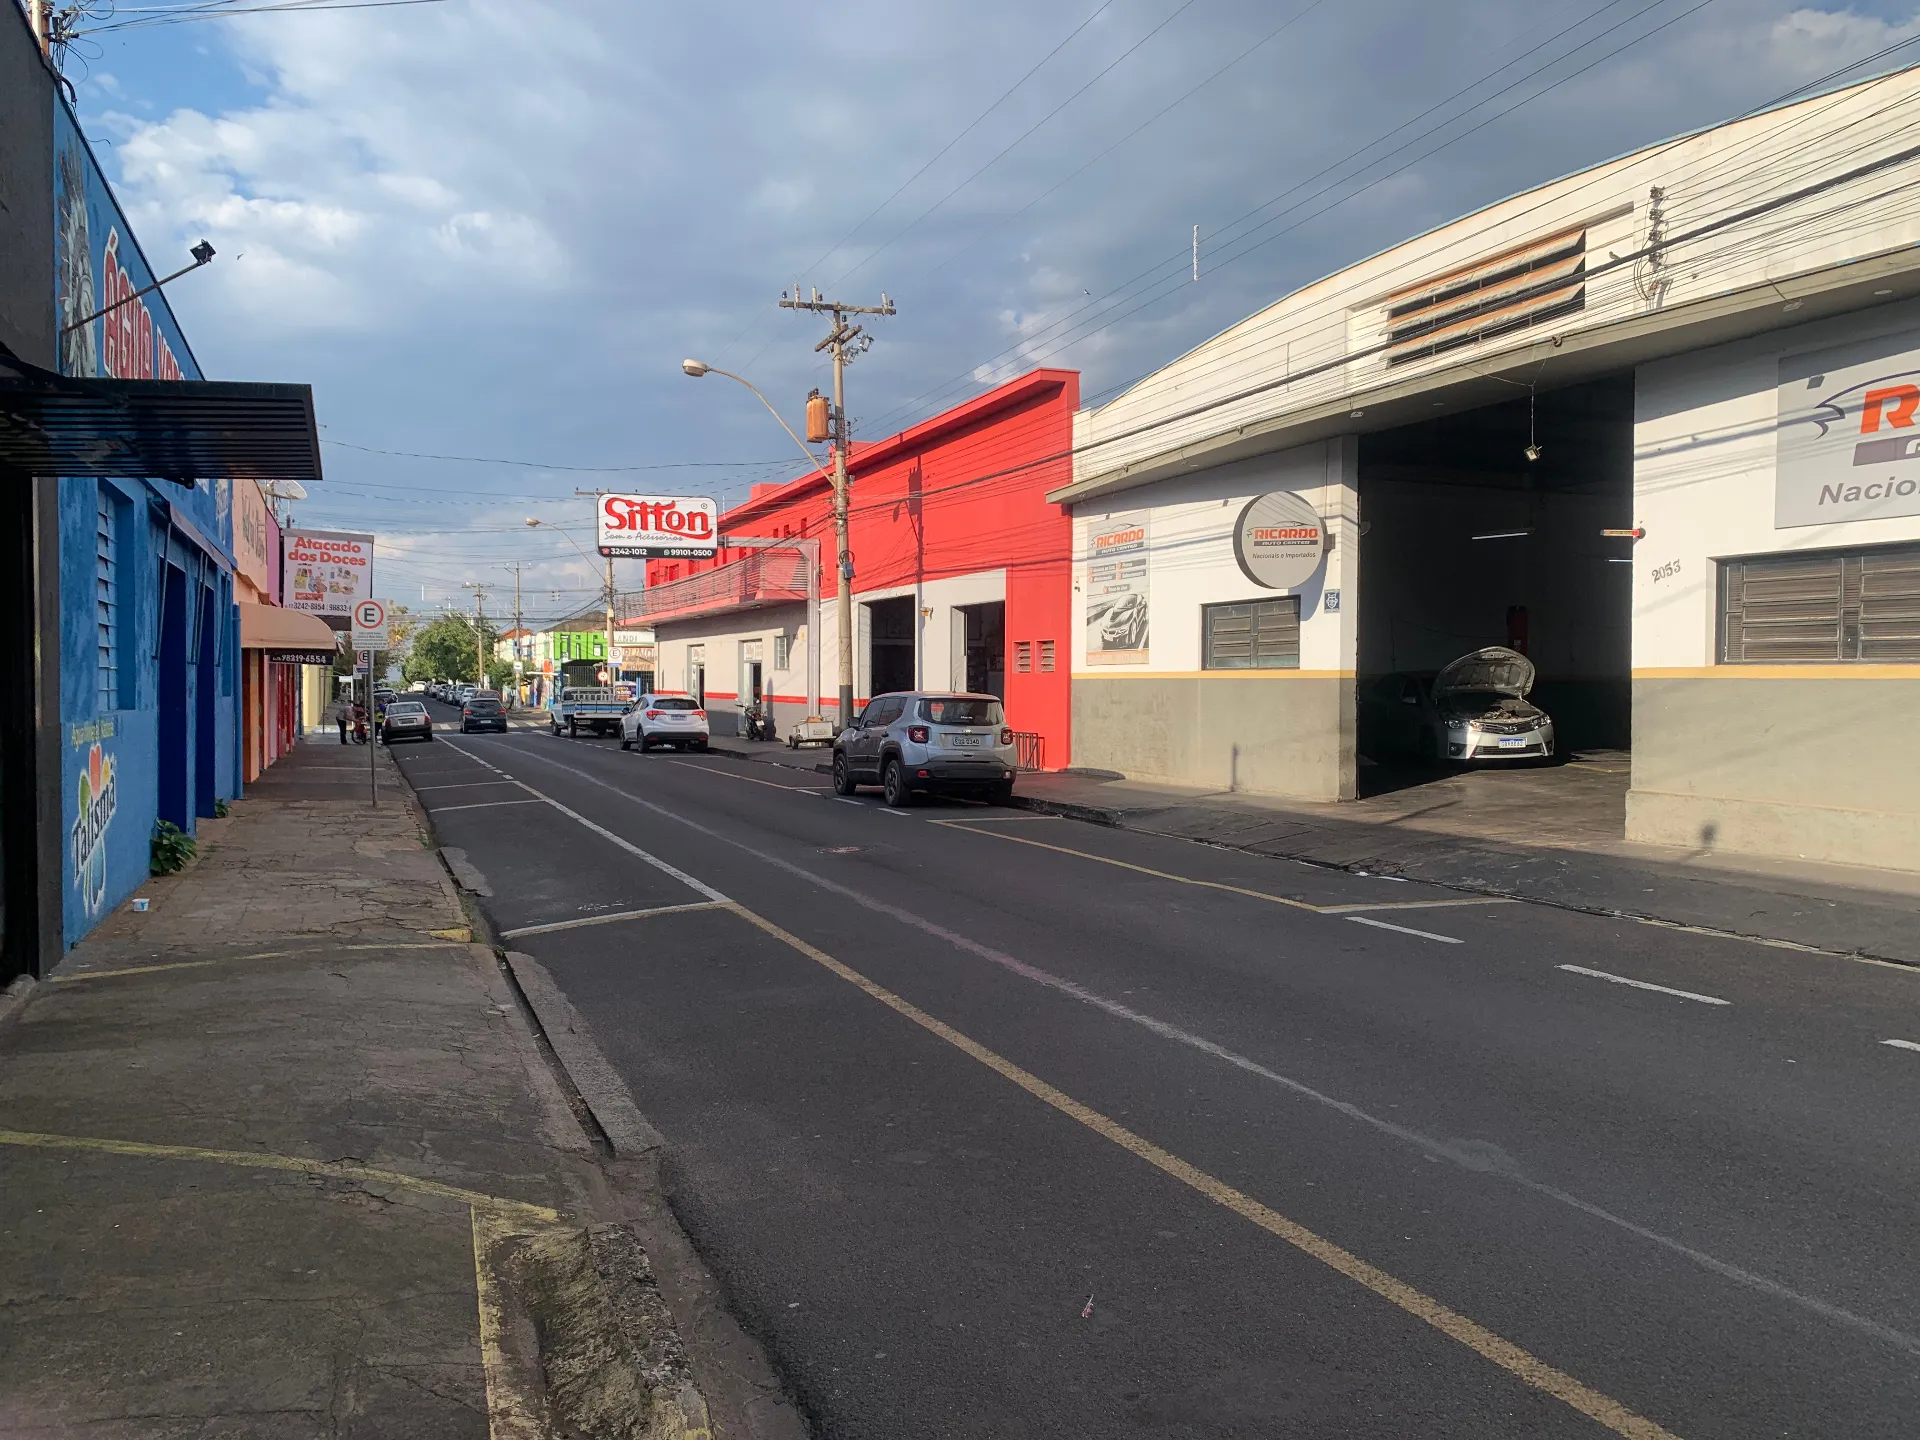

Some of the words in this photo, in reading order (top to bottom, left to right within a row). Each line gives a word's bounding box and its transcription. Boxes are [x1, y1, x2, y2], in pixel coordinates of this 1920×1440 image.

[1819, 476, 1920, 505] Nacio
[604, 531, 625, 540] Som
[1096, 528, 1145, 549] RICARDO
[1254, 528, 1318, 540] RICARDO
[294, 536, 361, 553] Atacado
[288, 549, 317, 562] dos
[319, 551, 367, 566] Doces
[1651, 558, 1681, 584] 2053
[363, 607, 375, 622] E
